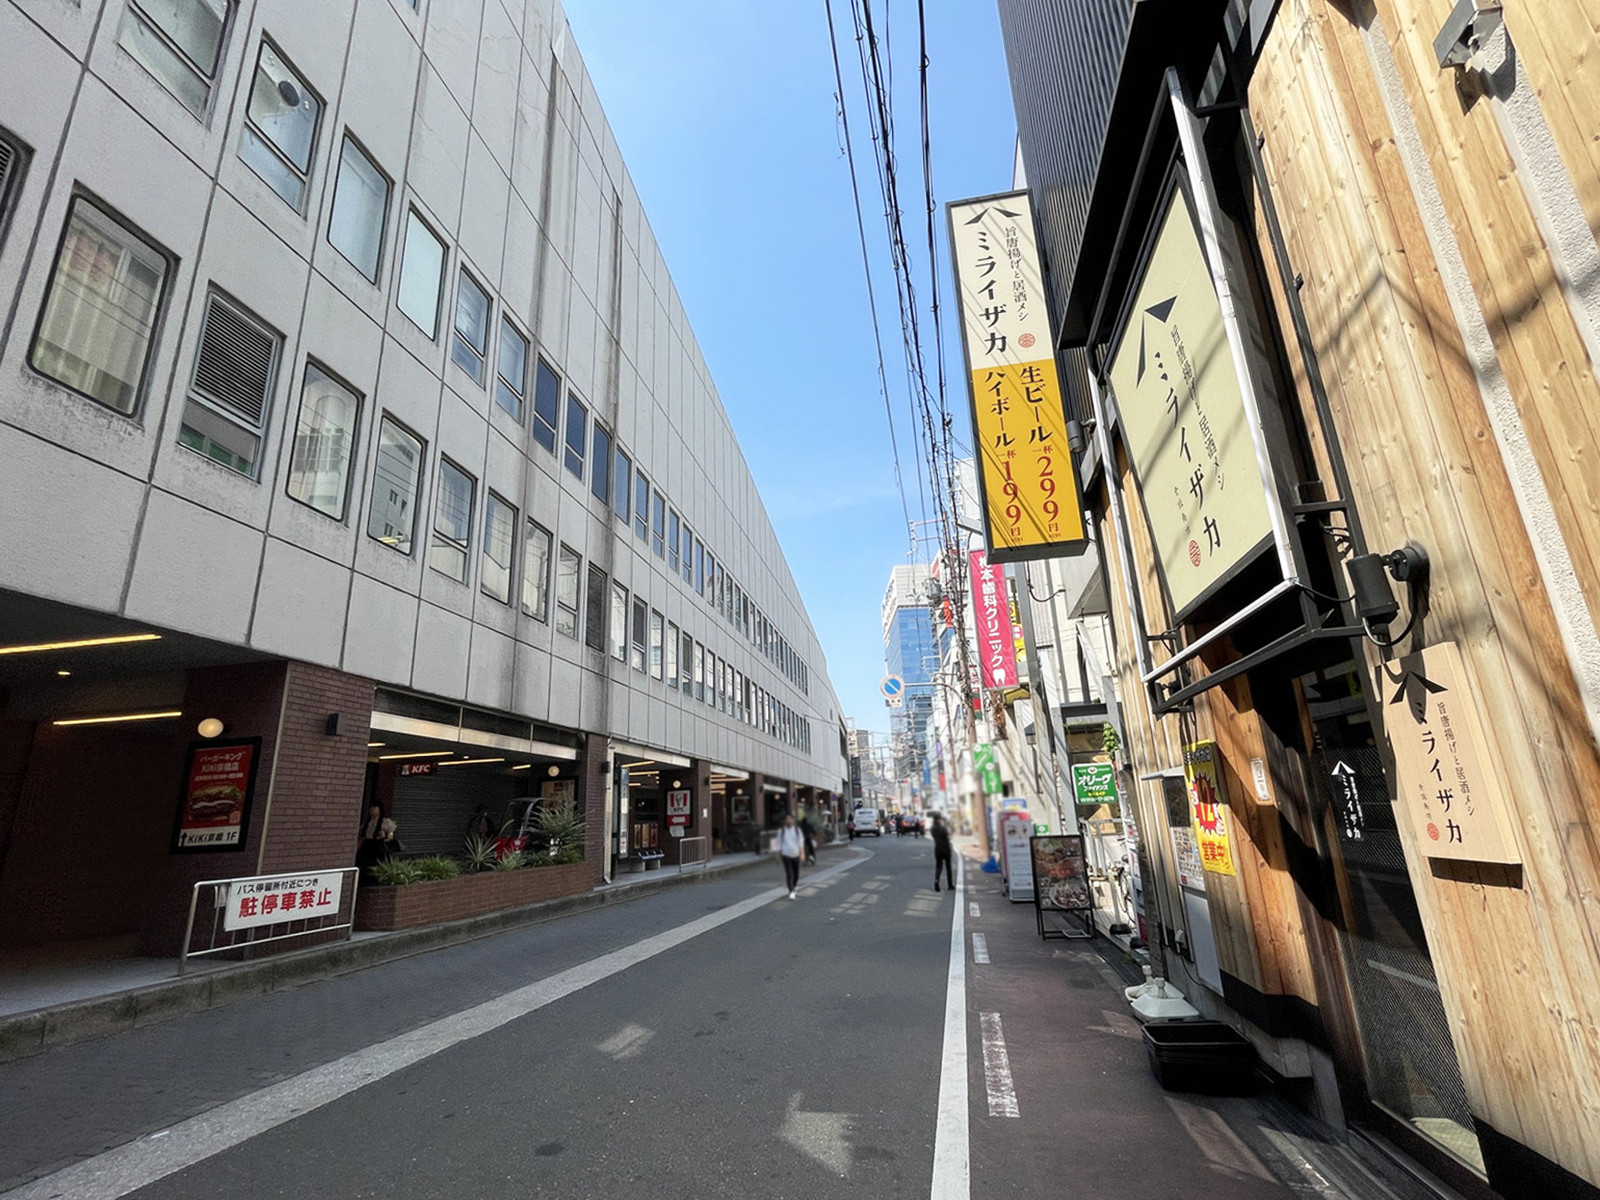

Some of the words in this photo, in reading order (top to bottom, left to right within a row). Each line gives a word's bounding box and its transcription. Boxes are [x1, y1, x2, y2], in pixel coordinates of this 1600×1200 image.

[974, 230, 1007, 356] ミライザカ
[1154, 350, 1222, 558] ミライザカ
[411, 764, 431, 774] KFC
[1415, 701, 1463, 845] ミライザカ
[237, 878, 319, 895] バス停留所付近につき
[238, 888, 332, 919] 駐停車禁止
